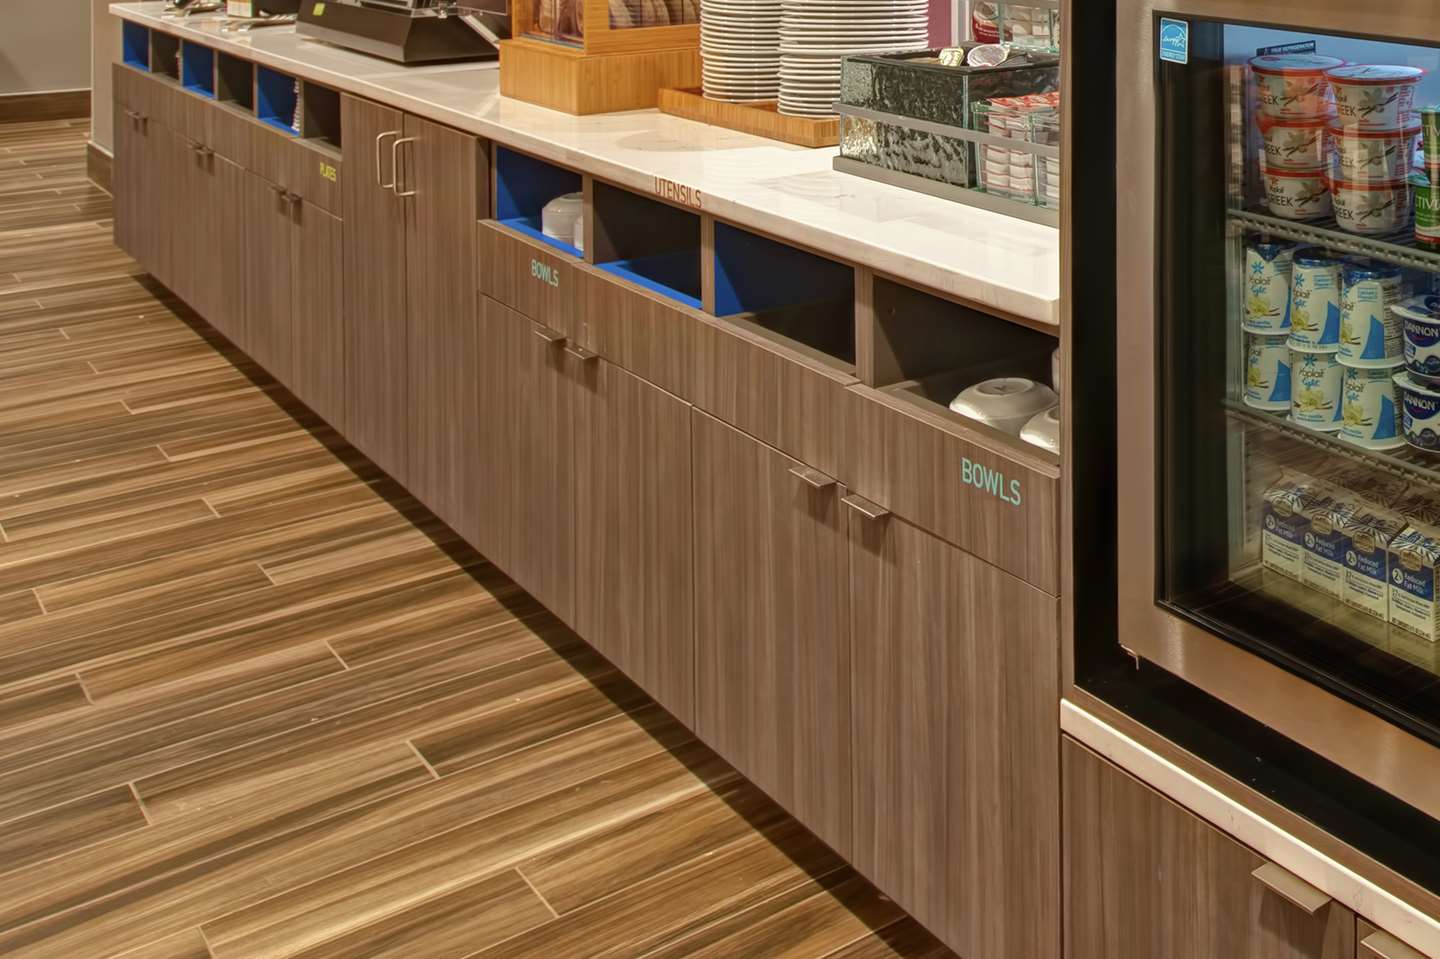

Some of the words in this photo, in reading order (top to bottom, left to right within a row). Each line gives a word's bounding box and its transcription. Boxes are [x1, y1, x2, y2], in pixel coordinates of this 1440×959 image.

[1263, 95, 1278, 105] EEK
[654, 176, 702, 209] UTENSILS
[531, 258, 559, 287] BOWLS
[1404, 320, 1439, 337] DANNON
[961, 457, 1022, 506] BOWLS
